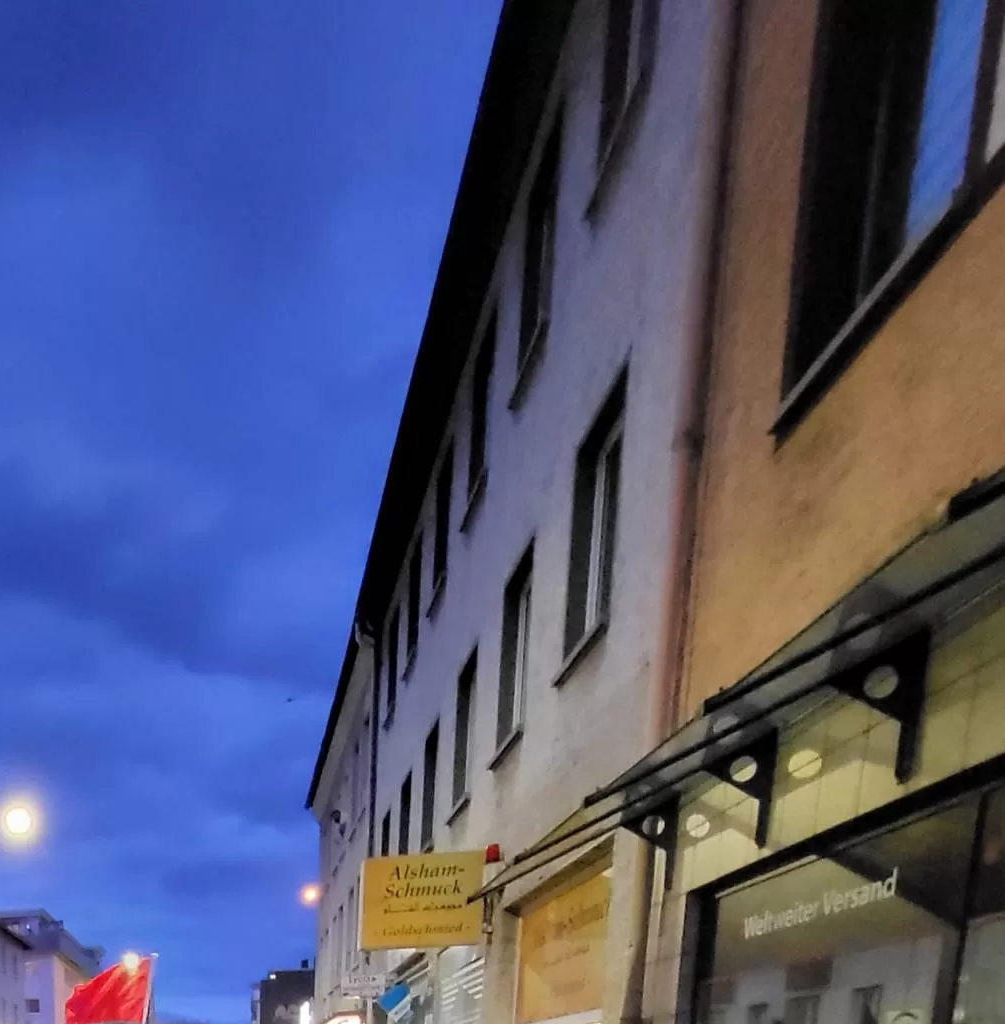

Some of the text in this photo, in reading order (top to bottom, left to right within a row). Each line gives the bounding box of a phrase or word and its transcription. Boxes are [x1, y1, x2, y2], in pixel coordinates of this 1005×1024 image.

[388, 863, 465, 881] Alsham-
[381, 879, 463, 901] Schmuck
[743, 865, 899, 941] Weltweiter Versand
